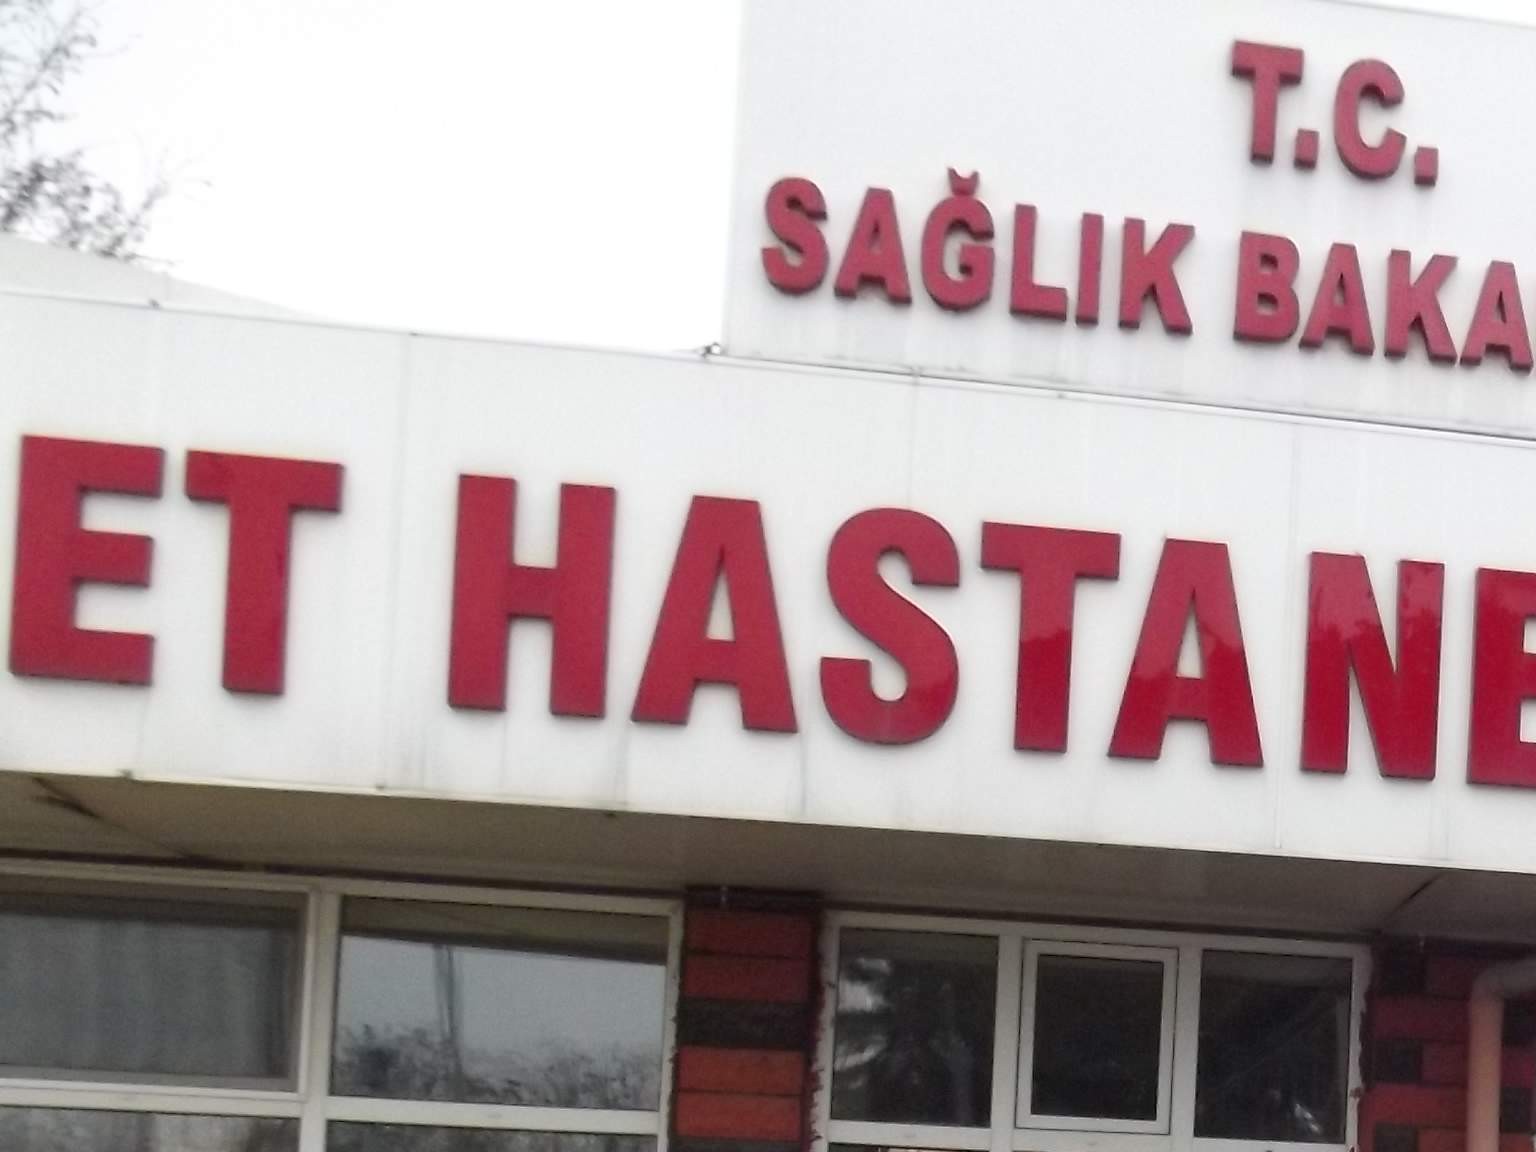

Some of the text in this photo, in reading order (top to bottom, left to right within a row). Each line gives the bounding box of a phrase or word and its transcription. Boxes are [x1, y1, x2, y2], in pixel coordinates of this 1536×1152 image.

[1231, 40, 1440, 187] T.C.
[760, 166, 1195, 335] SAĞLIK
[8, 434, 344, 697] ET
